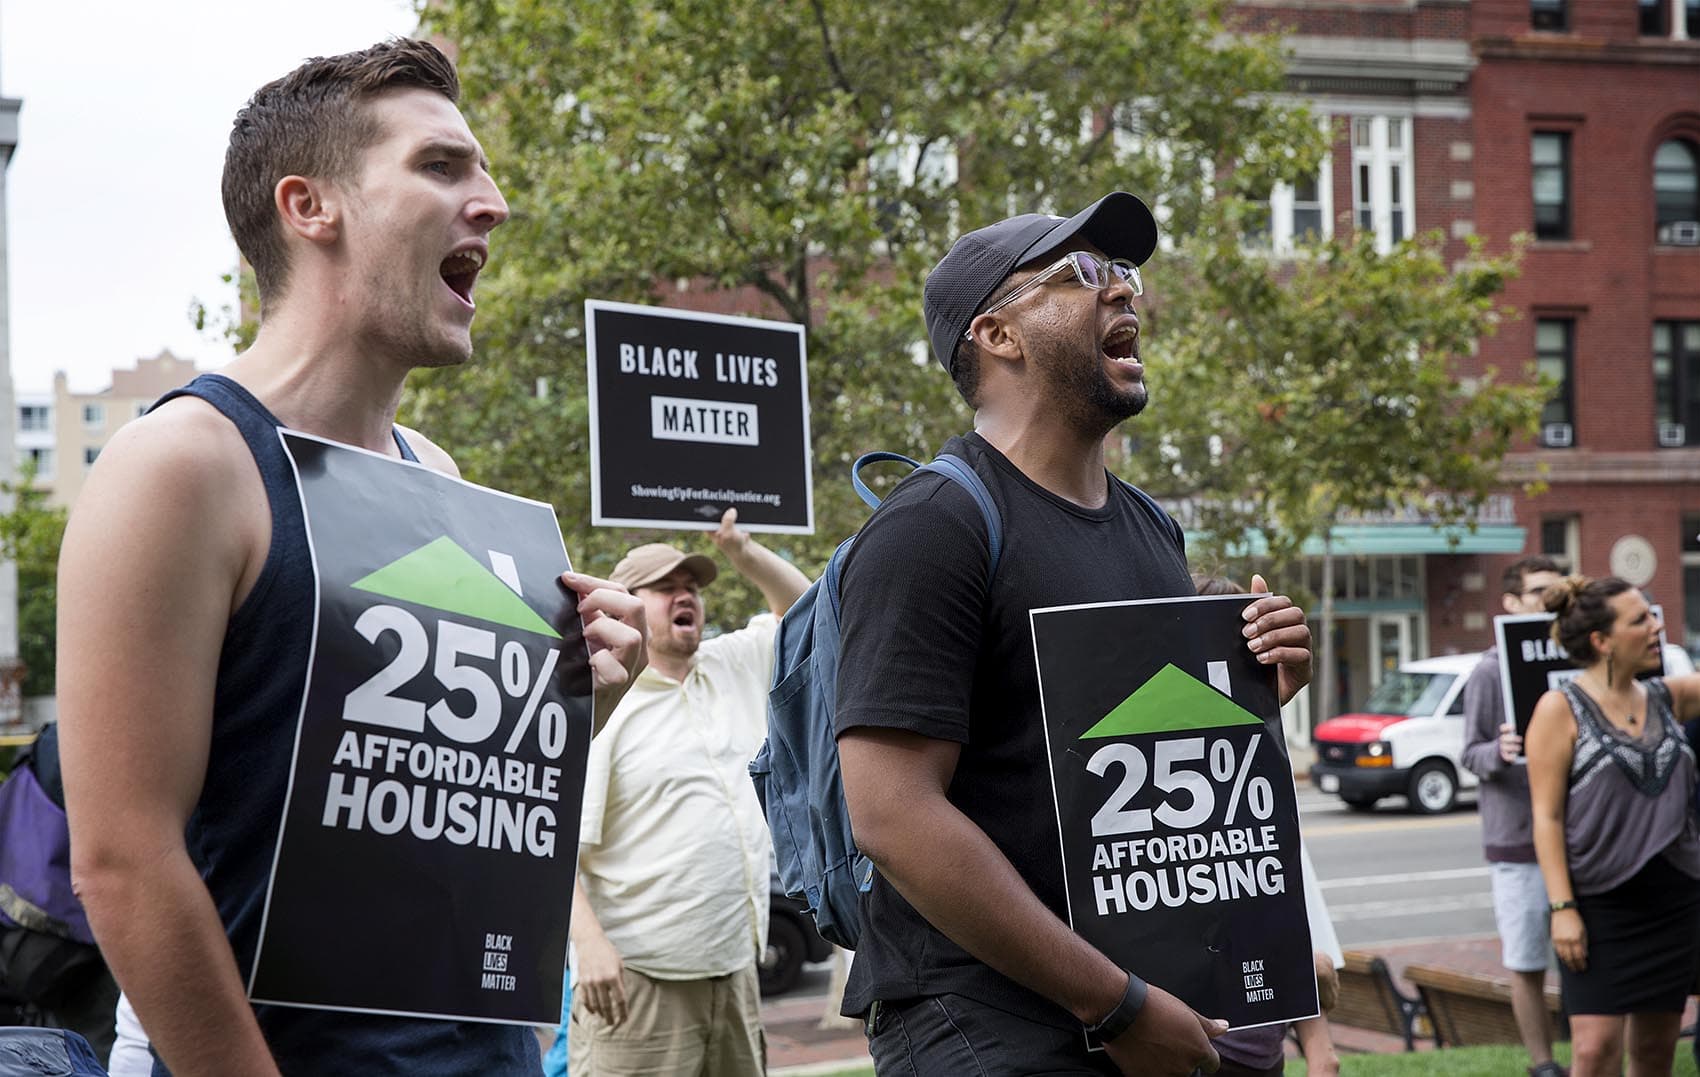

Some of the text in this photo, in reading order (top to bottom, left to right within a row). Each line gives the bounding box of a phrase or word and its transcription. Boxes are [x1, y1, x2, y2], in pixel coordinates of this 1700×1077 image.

[619, 343, 778, 387] BLACK LIVES
[662, 405, 749, 436] MATTER
[631, 484, 781, 507] ShowingUpForRacialJustice.org
[1521, 638, 1570, 662] BLA
[342, 604, 568, 760] 25%
[332, 730, 562, 802] AFFORDABLE
[1085, 733, 1275, 838] 25%
[321, 771, 557, 859] HOUSING
[1092, 825, 1280, 871] AFFORDABLE
[1092, 856, 1286, 916] HOUSING
[485, 933, 513, 951] BLACK
[485, 954, 506, 969] LIVES
[1242, 959, 1264, 973] BLACK
[481, 973, 516, 991] MATTER
[1245, 975, 1263, 988] LIVES
[1246, 988, 1274, 1003] MATTER
